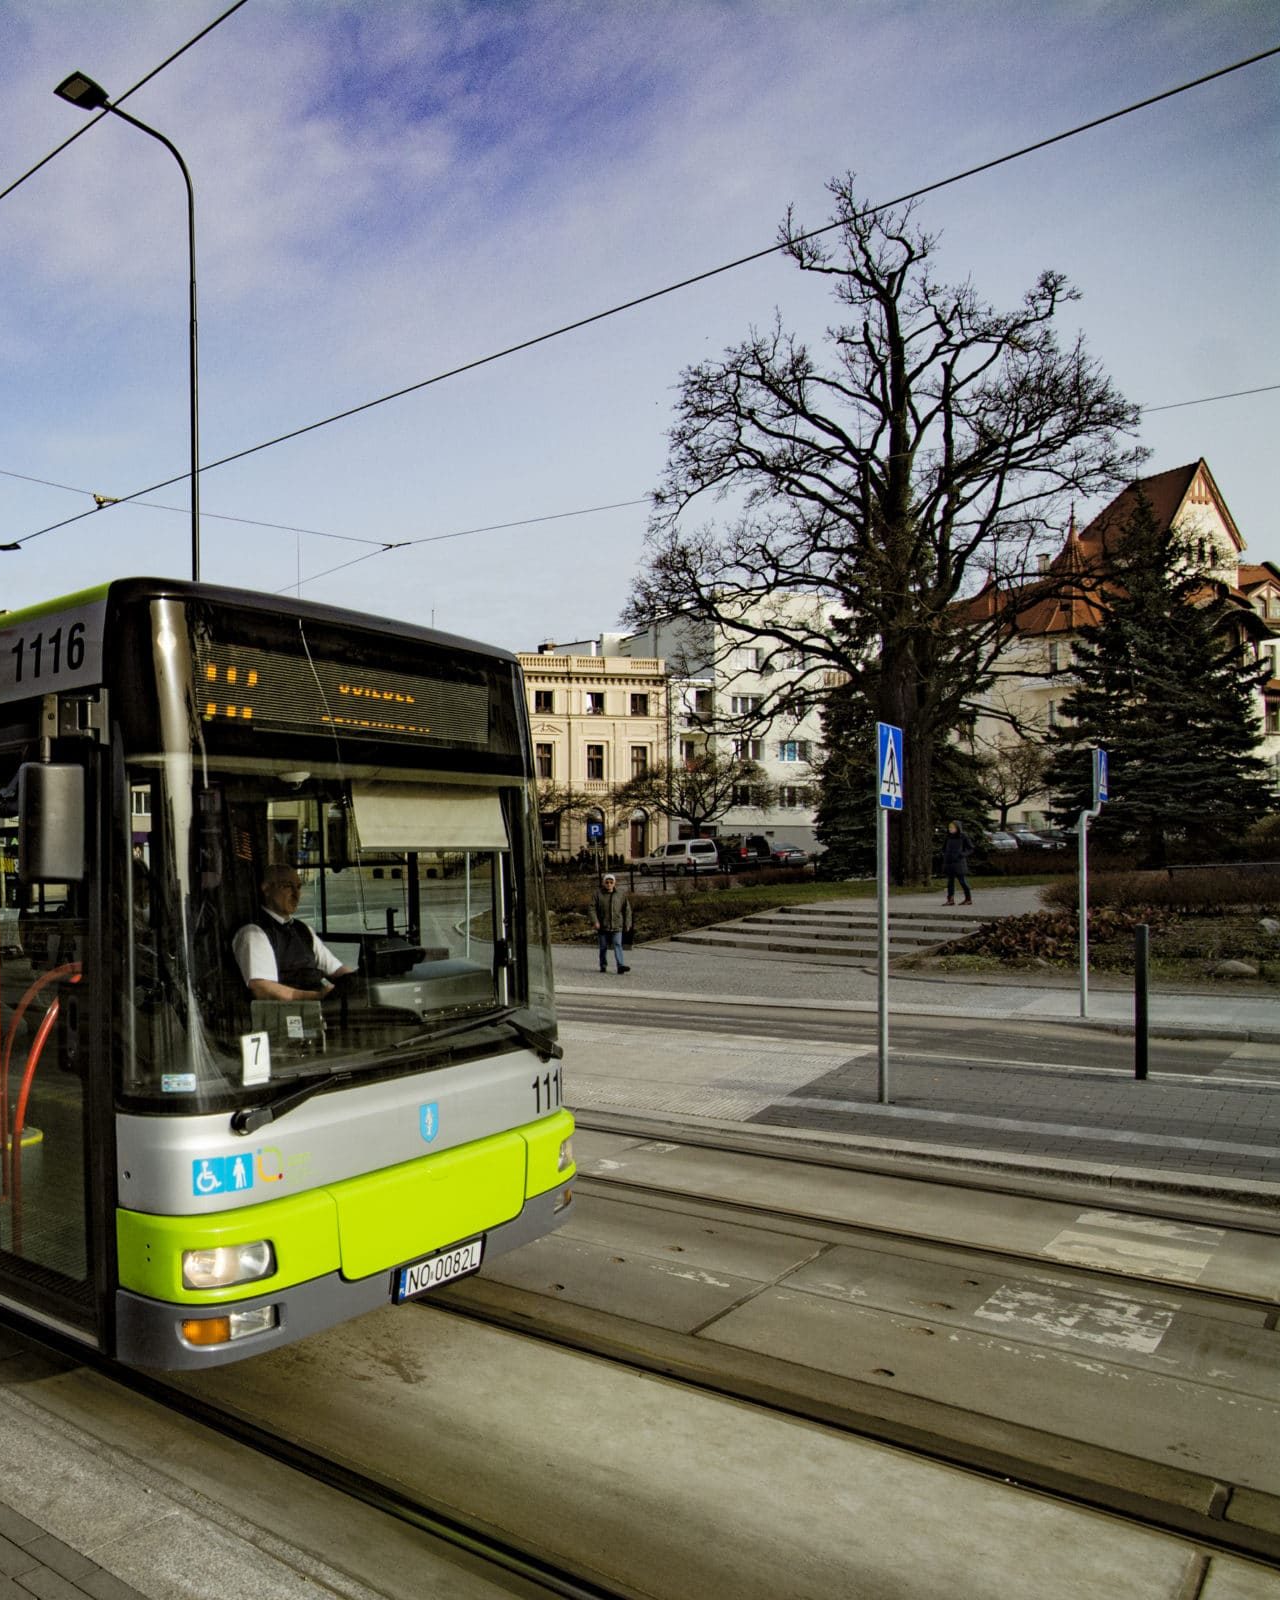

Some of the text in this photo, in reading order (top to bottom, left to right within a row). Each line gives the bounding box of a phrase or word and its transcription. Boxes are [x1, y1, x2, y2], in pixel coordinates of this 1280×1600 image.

[12, 622, 85, 682] 1116
[591, 825, 600, 835] P
[251, 1037, 261, 1066] 7
[532, 1067, 563, 1114] 111
[409, 1246, 477, 1293] NO 0082L
